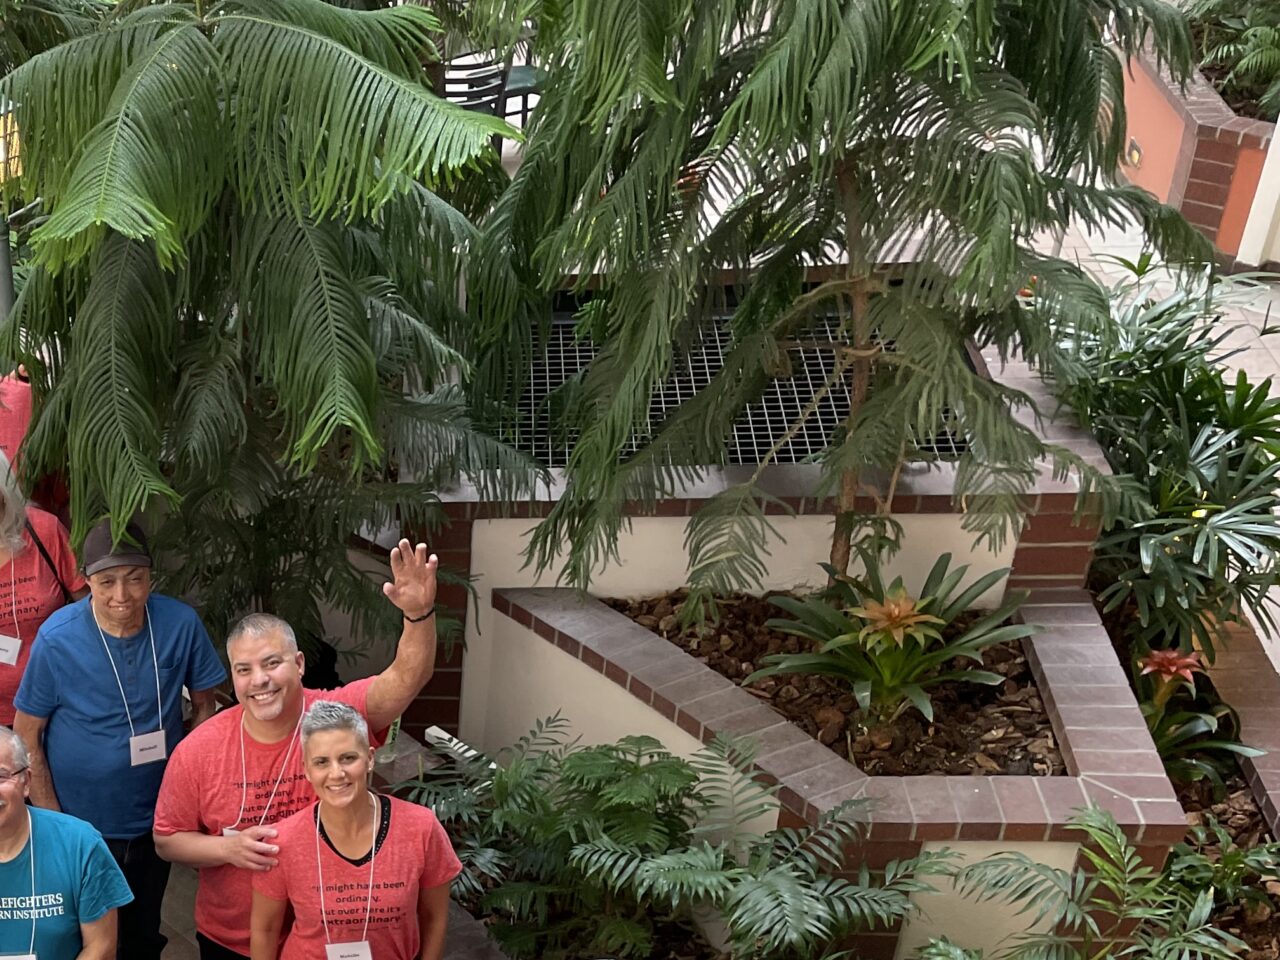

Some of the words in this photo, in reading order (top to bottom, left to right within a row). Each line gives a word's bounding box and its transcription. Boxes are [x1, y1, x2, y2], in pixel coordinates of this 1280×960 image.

[18, 576, 37, 584] been
[326, 883, 354, 893] might
[383, 881, 405, 889] been
[13, 906, 65, 919] INSTITUTE
